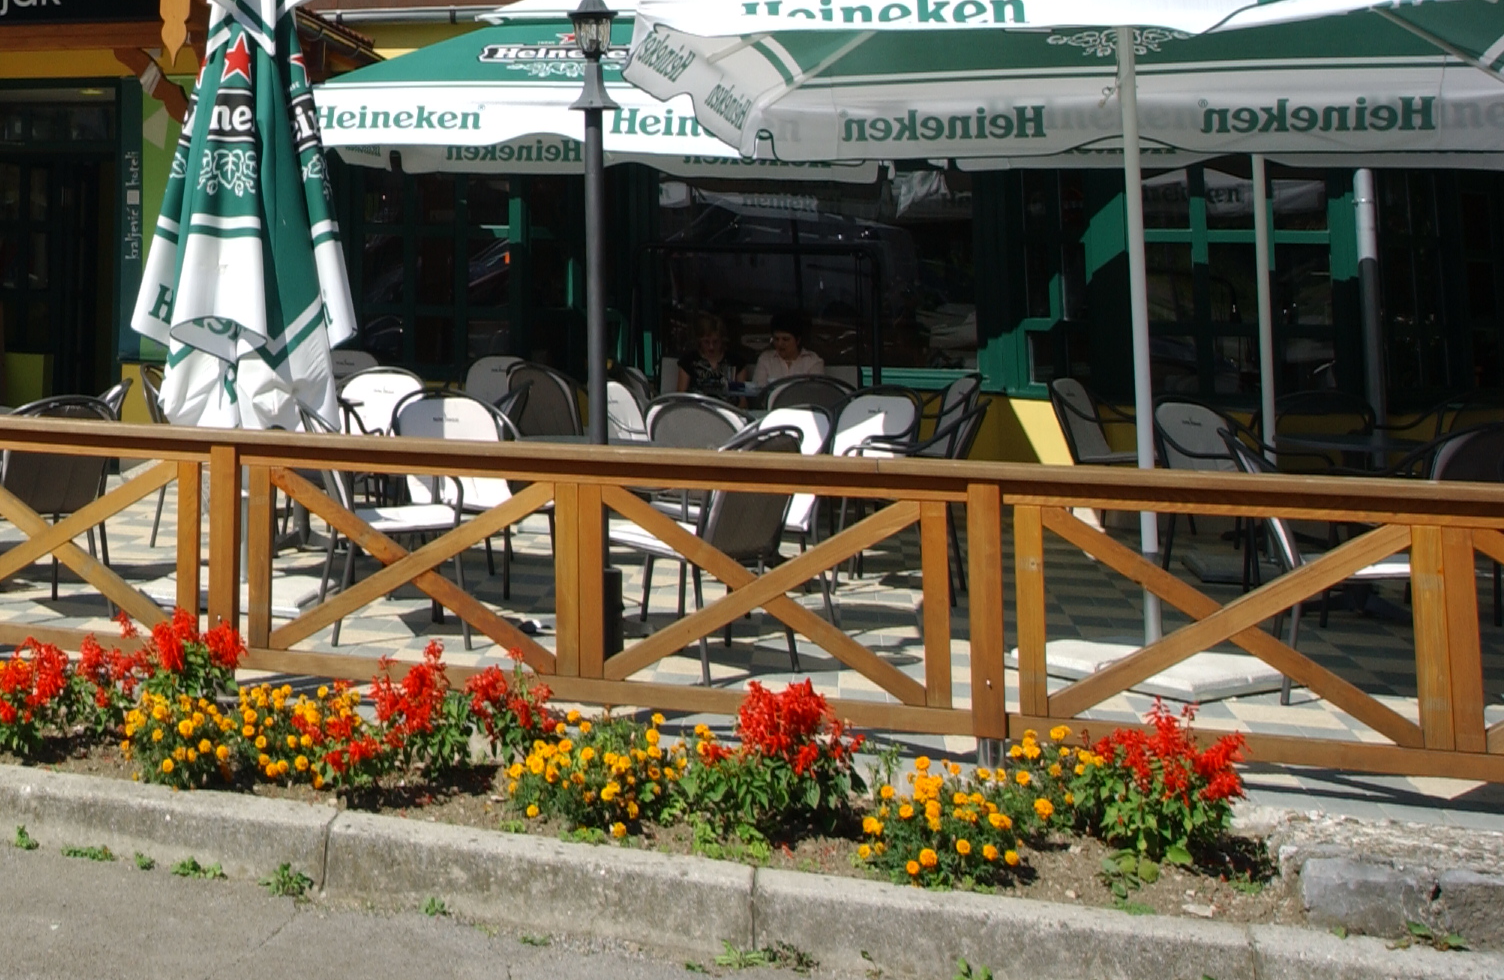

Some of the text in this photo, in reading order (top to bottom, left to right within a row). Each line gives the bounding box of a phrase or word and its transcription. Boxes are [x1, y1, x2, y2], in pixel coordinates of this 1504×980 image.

[494, 46, 630, 60] Heinee
[316, 105, 481, 130] Heineken
[609, 108, 718, 138] Hein
[124, 151, 139, 186] hoteli
